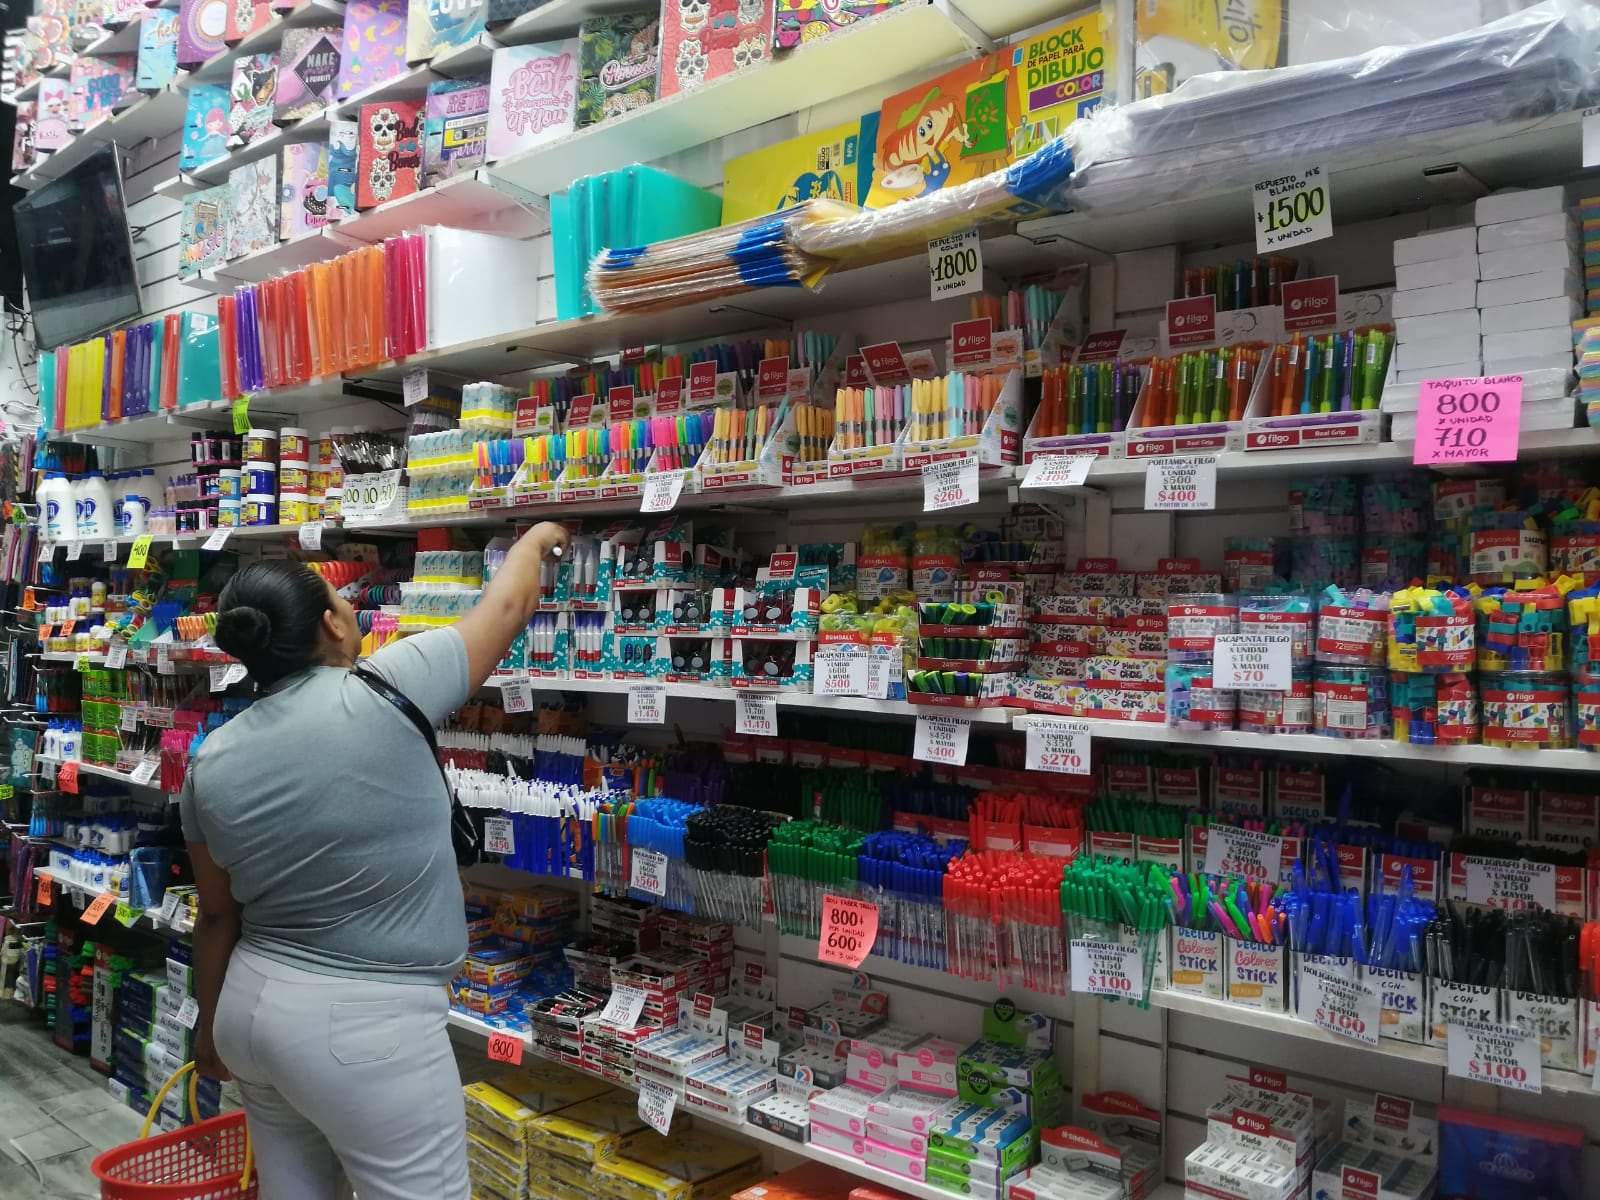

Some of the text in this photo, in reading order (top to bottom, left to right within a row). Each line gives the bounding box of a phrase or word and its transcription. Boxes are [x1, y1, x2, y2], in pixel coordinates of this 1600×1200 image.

[1028, 26, 1084, 60] BLOCK
[306, 51, 335, 67] MAKE
[1027, 43, 1085, 69] DE PAPEL PARA
[1027, 46, 1104, 90] DIBUJO
[509, 53, 573, 100] Best
[1055, 73, 1101, 98] COLOR
[446, 89, 490, 115] RETR
[1254, 175, 1297, 192] REPUESTO
[1268, 181, 1307, 196] BLANCO
[1277, 227, 1313, 242] UNIDAD
[929, 234, 963, 249] REPUESTO
[940, 241, 964, 252] COLOR
[942, 280, 966, 291] UNIDAD
[1303, 296, 1329, 309] filgo
[1186, 313, 1209, 325] filgo
[967, 334, 986, 347] filgo
[880, 355, 899, 368] filgo
[700, 375, 713, 385] filgo
[769, 371, 785, 382] filgo
[1427, 375, 1523, 390] TAQUITO BLANCO
[1436, 391, 1501, 415] 800
[1449, 415, 1494, 425] UNIDAD
[1331, 428, 1347, 438] Grip
[1434, 427, 1487, 448] 710
[1267, 433, 1290, 446] filgo
[1145, 442, 1165, 452] filgo
[1431, 448, 1489, 459] X MAYOR
[1193, 456, 1216, 465] FILGO
[1035, 473, 1070, 482] $400
[1167, 469, 1197, 477] UNIDAD
[1163, 475, 1192, 484] $500
[933, 488, 963, 504] $260
[1158, 490, 1197, 502] $400
[1577, 537, 1596, 546] filgo
[1266, 613, 1283, 621] filgo
[1347, 609, 1365, 617] filgo
[1145, 619, 1163, 628] filgo
[1455, 616, 1469, 625] filgo
[1217, 635, 1290, 643] SACAPUNTA FILGO
[1064, 644, 1080, 654] filgo
[1335, 642, 1344, 650] 72
[1232, 654, 1262, 662] $100
[1447, 653, 1456, 661] 72
[1234, 670, 1264, 682] $70
[825, 680, 850, 689] $500
[1515, 693, 1535, 702] filgo
[634, 709, 659, 719] $1.470
[743, 719, 771, 730] $1.470
[917, 714, 951, 726] SACAPUNTA
[952, 718, 971, 727] FILGO
[1028, 721, 1089, 732] SACAPUNTA FILGO
[929, 732, 952, 740] $450
[933, 726, 957, 734] UNIDAD
[1506, 729, 1518, 738] 72
[935, 740, 956, 748] MAYOR
[1045, 740, 1072, 748] $350
[927, 746, 955, 759] $400
[1041, 753, 1081, 768] $270
[1281, 806, 1320, 818] DECILO
[1210, 823, 1280, 844] BOLIGRAFO FILGO
[489, 840, 510, 850] $450
[1232, 839, 1262, 851] UNIDAD
[1229, 846, 1258, 859] $360
[1234, 855, 1262, 866] MAYOR
[1466, 856, 1551, 873] BOLIGRAFO FILGO
[1221, 859, 1267, 879] $300
[634, 875, 660, 889] $560
[1495, 873, 1531, 883] UNIDAD
[1493, 880, 1529, 892] $150
[1501, 889, 1534, 901] MAYOR
[1178, 927, 1217, 941] DECILO
[1071, 940, 1138, 954] BOLIGRAFO FILGO
[1177, 940, 1217, 957] Colores
[1094, 954, 1124, 963] UNIDAD
[1234, 951, 1278, 970] Colores
[1093, 961, 1122, 970] $150
[1099, 969, 1126, 978] MAYOR
[1304, 965, 1350, 987] BOLIGRAFO
[1088, 975, 1132, 992] $100
[1325, 986, 1359, 1002] UNIDAD
[609, 1009, 630, 1022] $770
[1328, 1004, 1360, 1019] MAYOR
[1315, 1007, 1366, 1034] $100
[1448, 1016, 1503, 1034] BOLIGRAFO
[1476, 1036, 1515, 1048] UNIDAD
[1475, 1043, 1513, 1058] $150
[1484, 1054, 1519, 1067] MAYOR
[1468, 1060, 1527, 1082] $100
[1263, 1074, 1283, 1088] filgo
[1246, 1117, 1266, 1132] filgo
[1356, 1175, 1374, 1189] filgo
